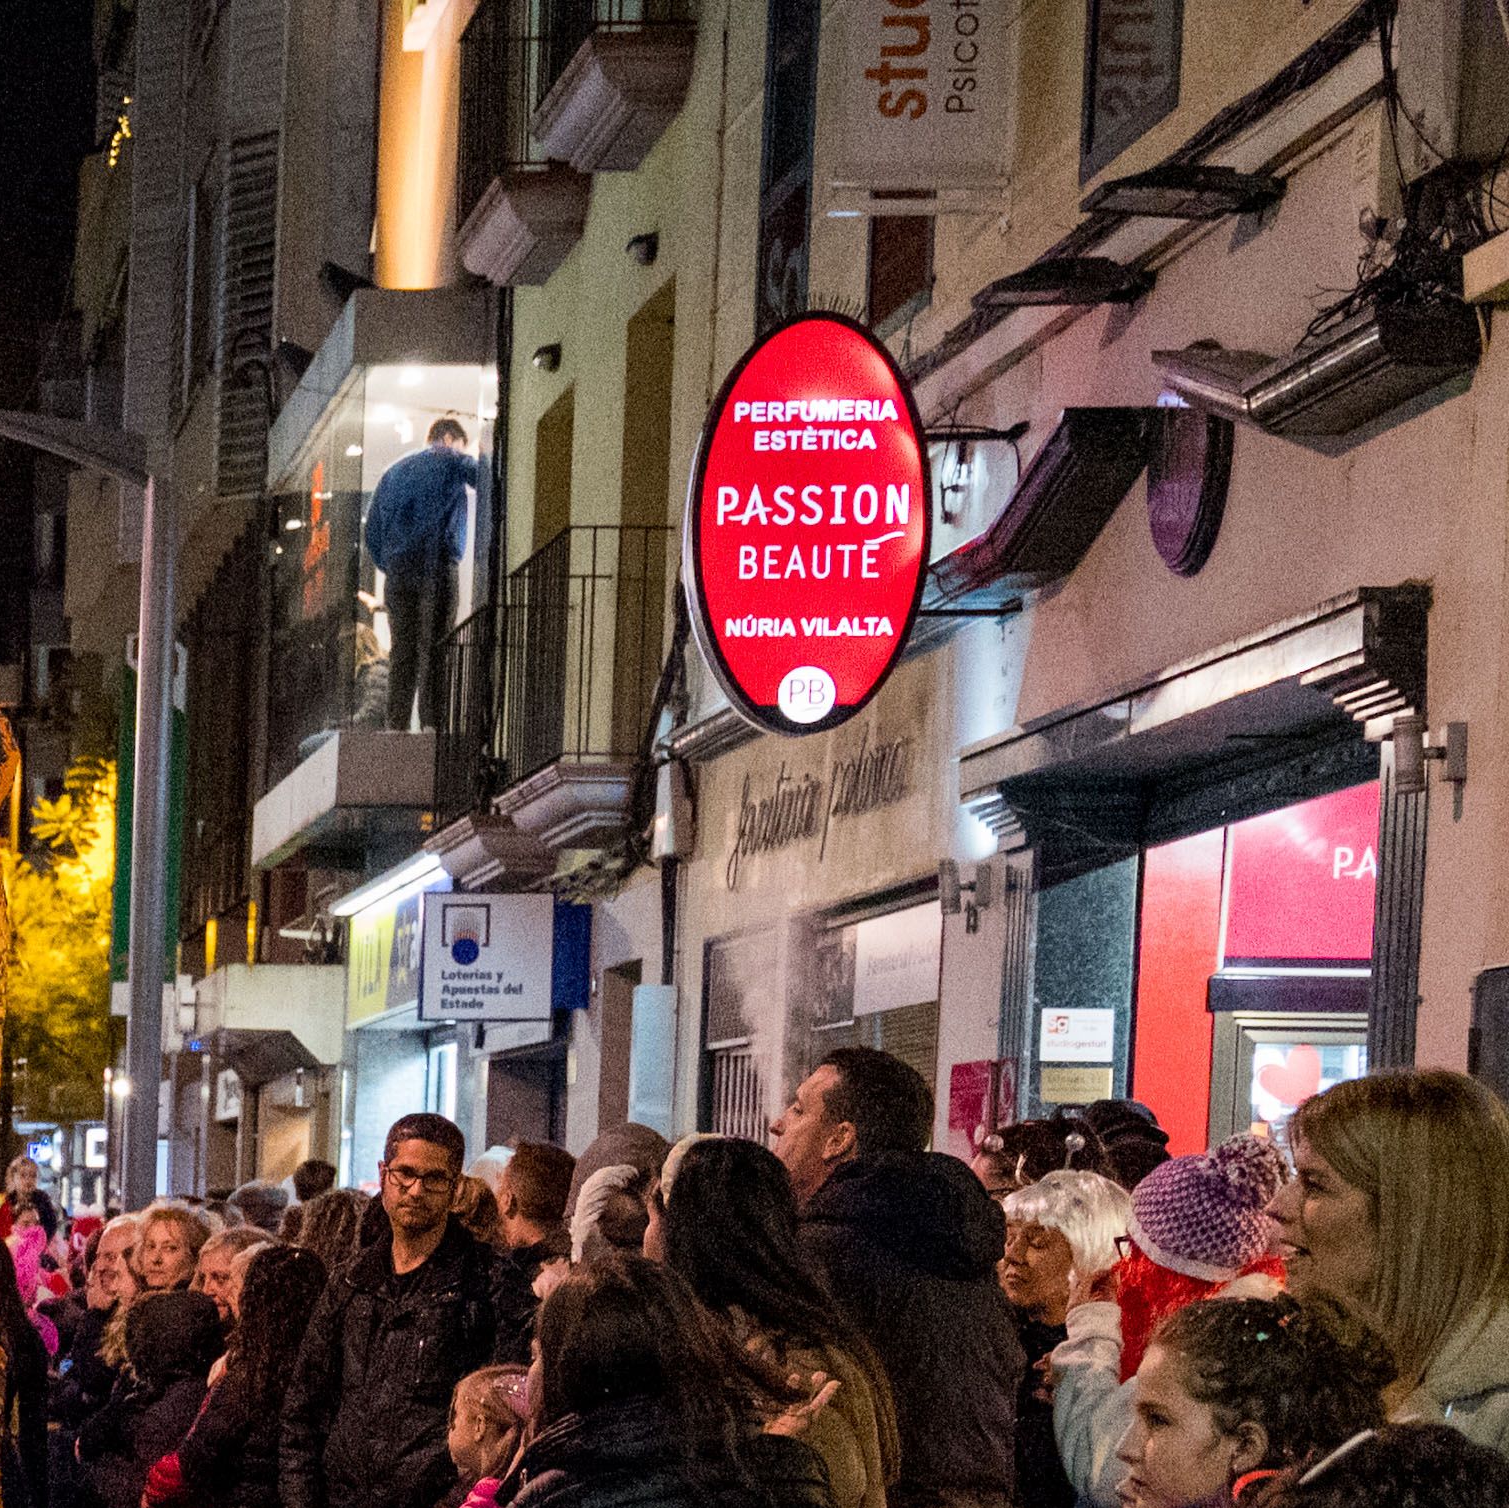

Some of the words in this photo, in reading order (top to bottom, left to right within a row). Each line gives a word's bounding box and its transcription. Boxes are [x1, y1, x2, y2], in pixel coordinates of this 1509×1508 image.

[864, 0, 930, 119] stu
[734, 399, 898, 423] PERFUMERIA
[754, 425, 877, 451] ESTÈTICA
[717, 483, 910, 526] PASSION
[725, 613, 796, 637] NÚRIA
[800, 616, 893, 637] VILALTA
[789, 679, 825, 705] PB
[496, 971, 504, 983] y
[442, 984, 500, 997] Apuestas
[503, 982, 523, 995] del
[440, 998, 484, 1009] Estado
